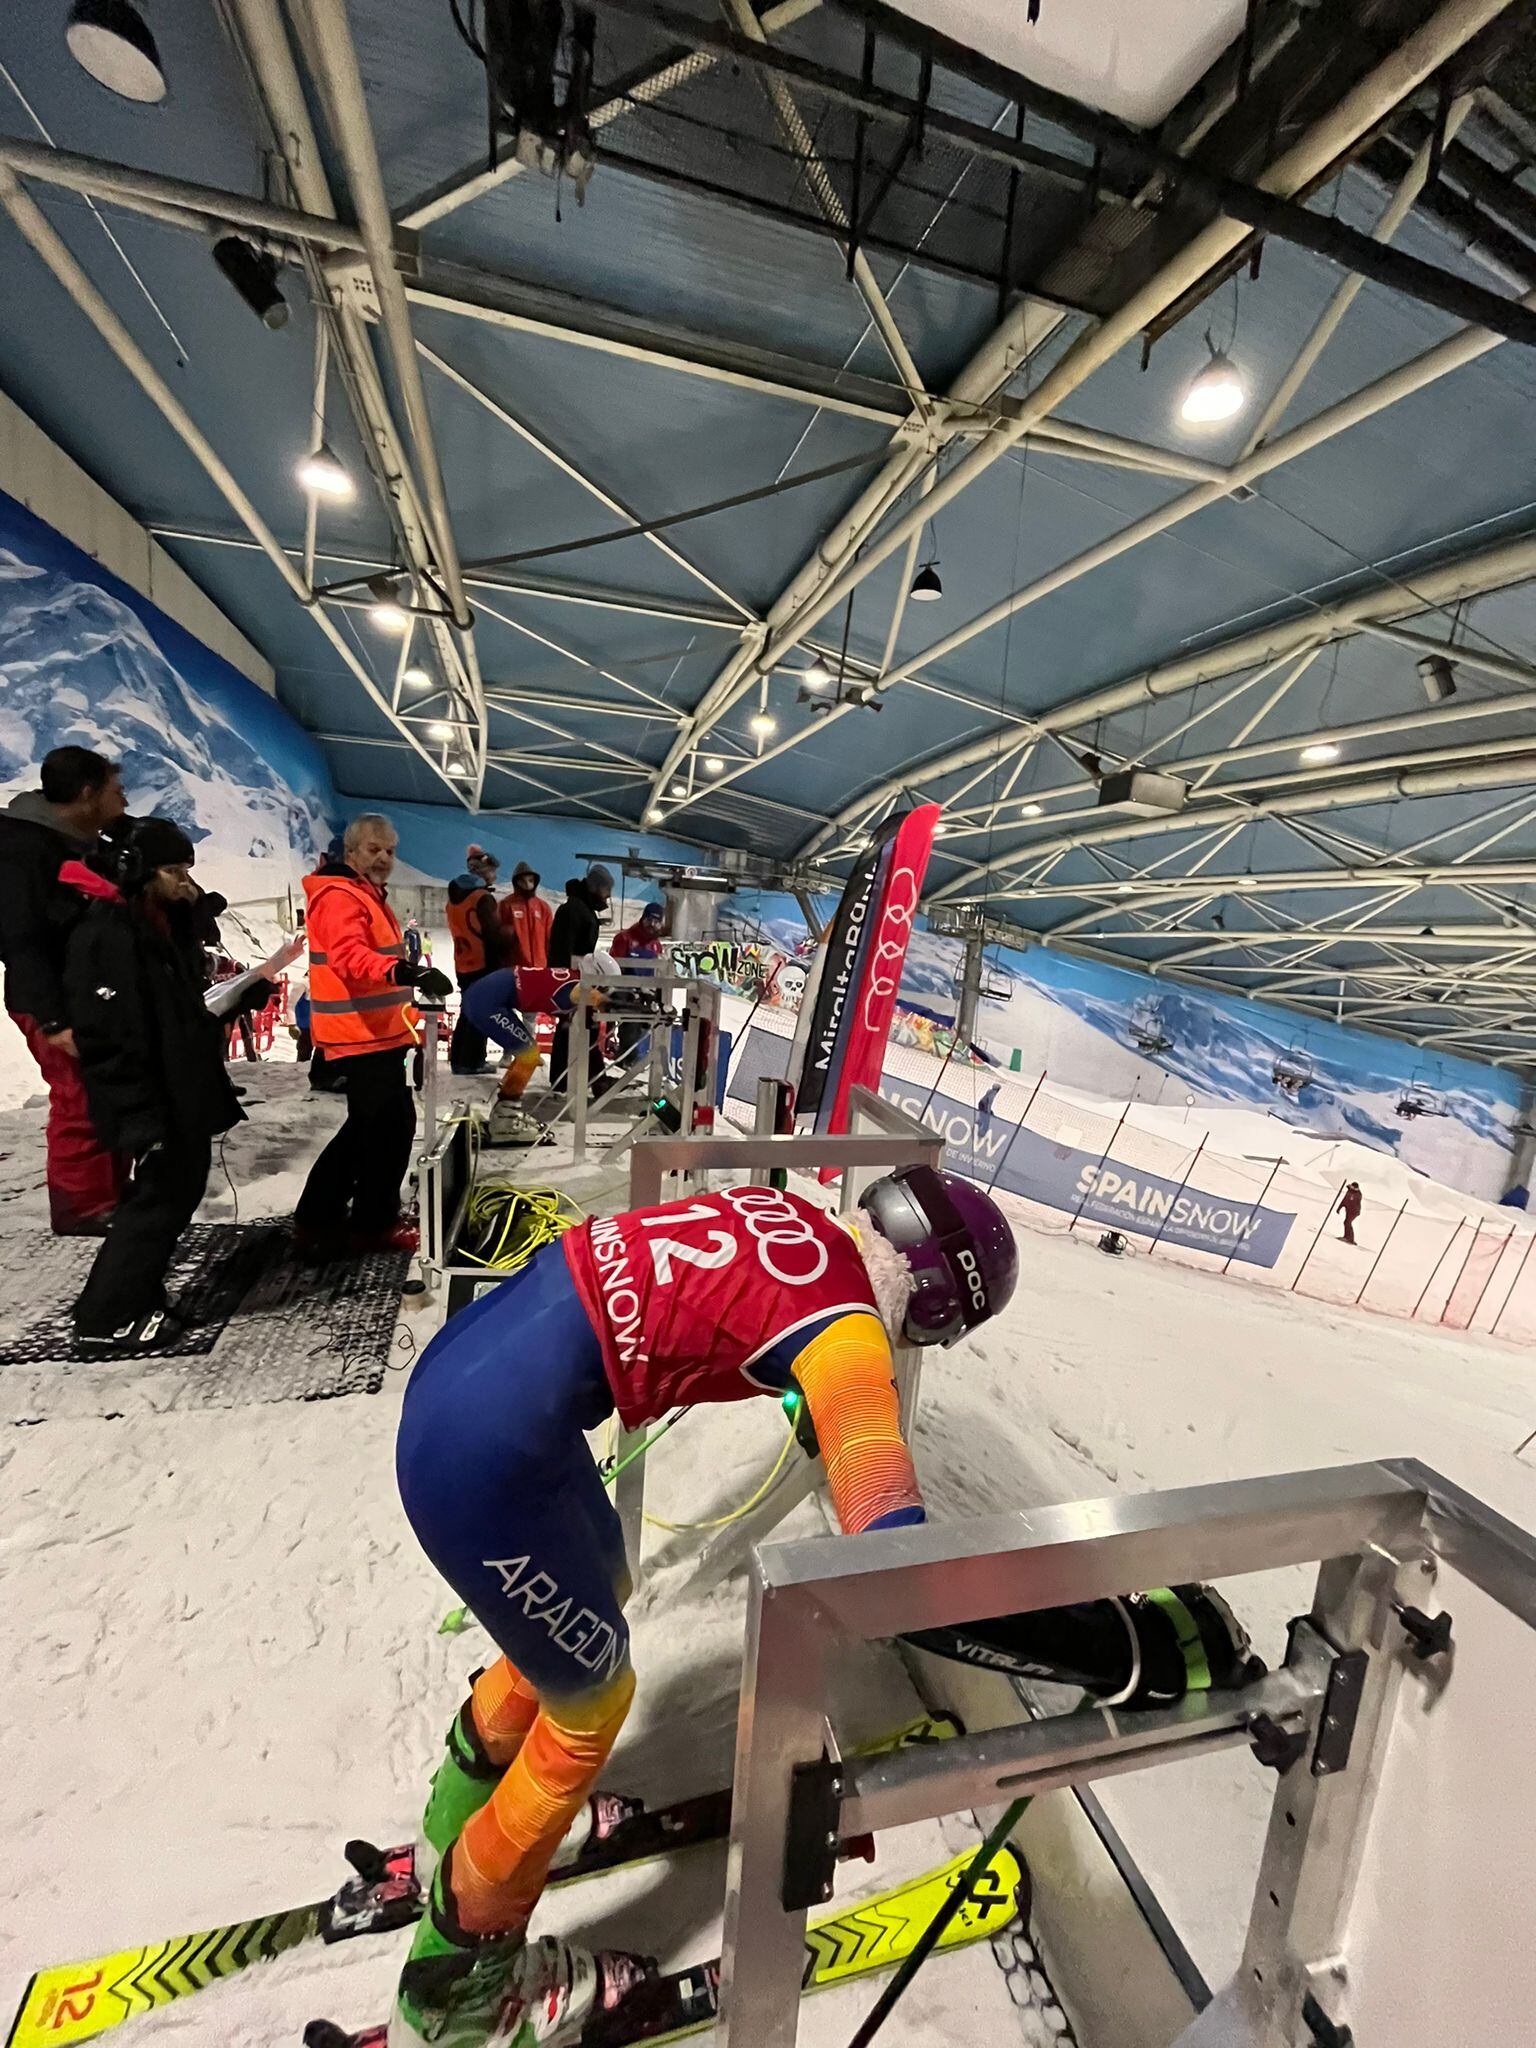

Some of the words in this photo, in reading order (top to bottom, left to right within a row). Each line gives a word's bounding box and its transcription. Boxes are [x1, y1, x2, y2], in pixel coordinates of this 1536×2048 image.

[737, 960, 767, 979] ZONE
[640, 1203, 738, 1286] 12
[956, 1249, 986, 1311] POC
[482, 1555, 628, 1682] ARAGON
